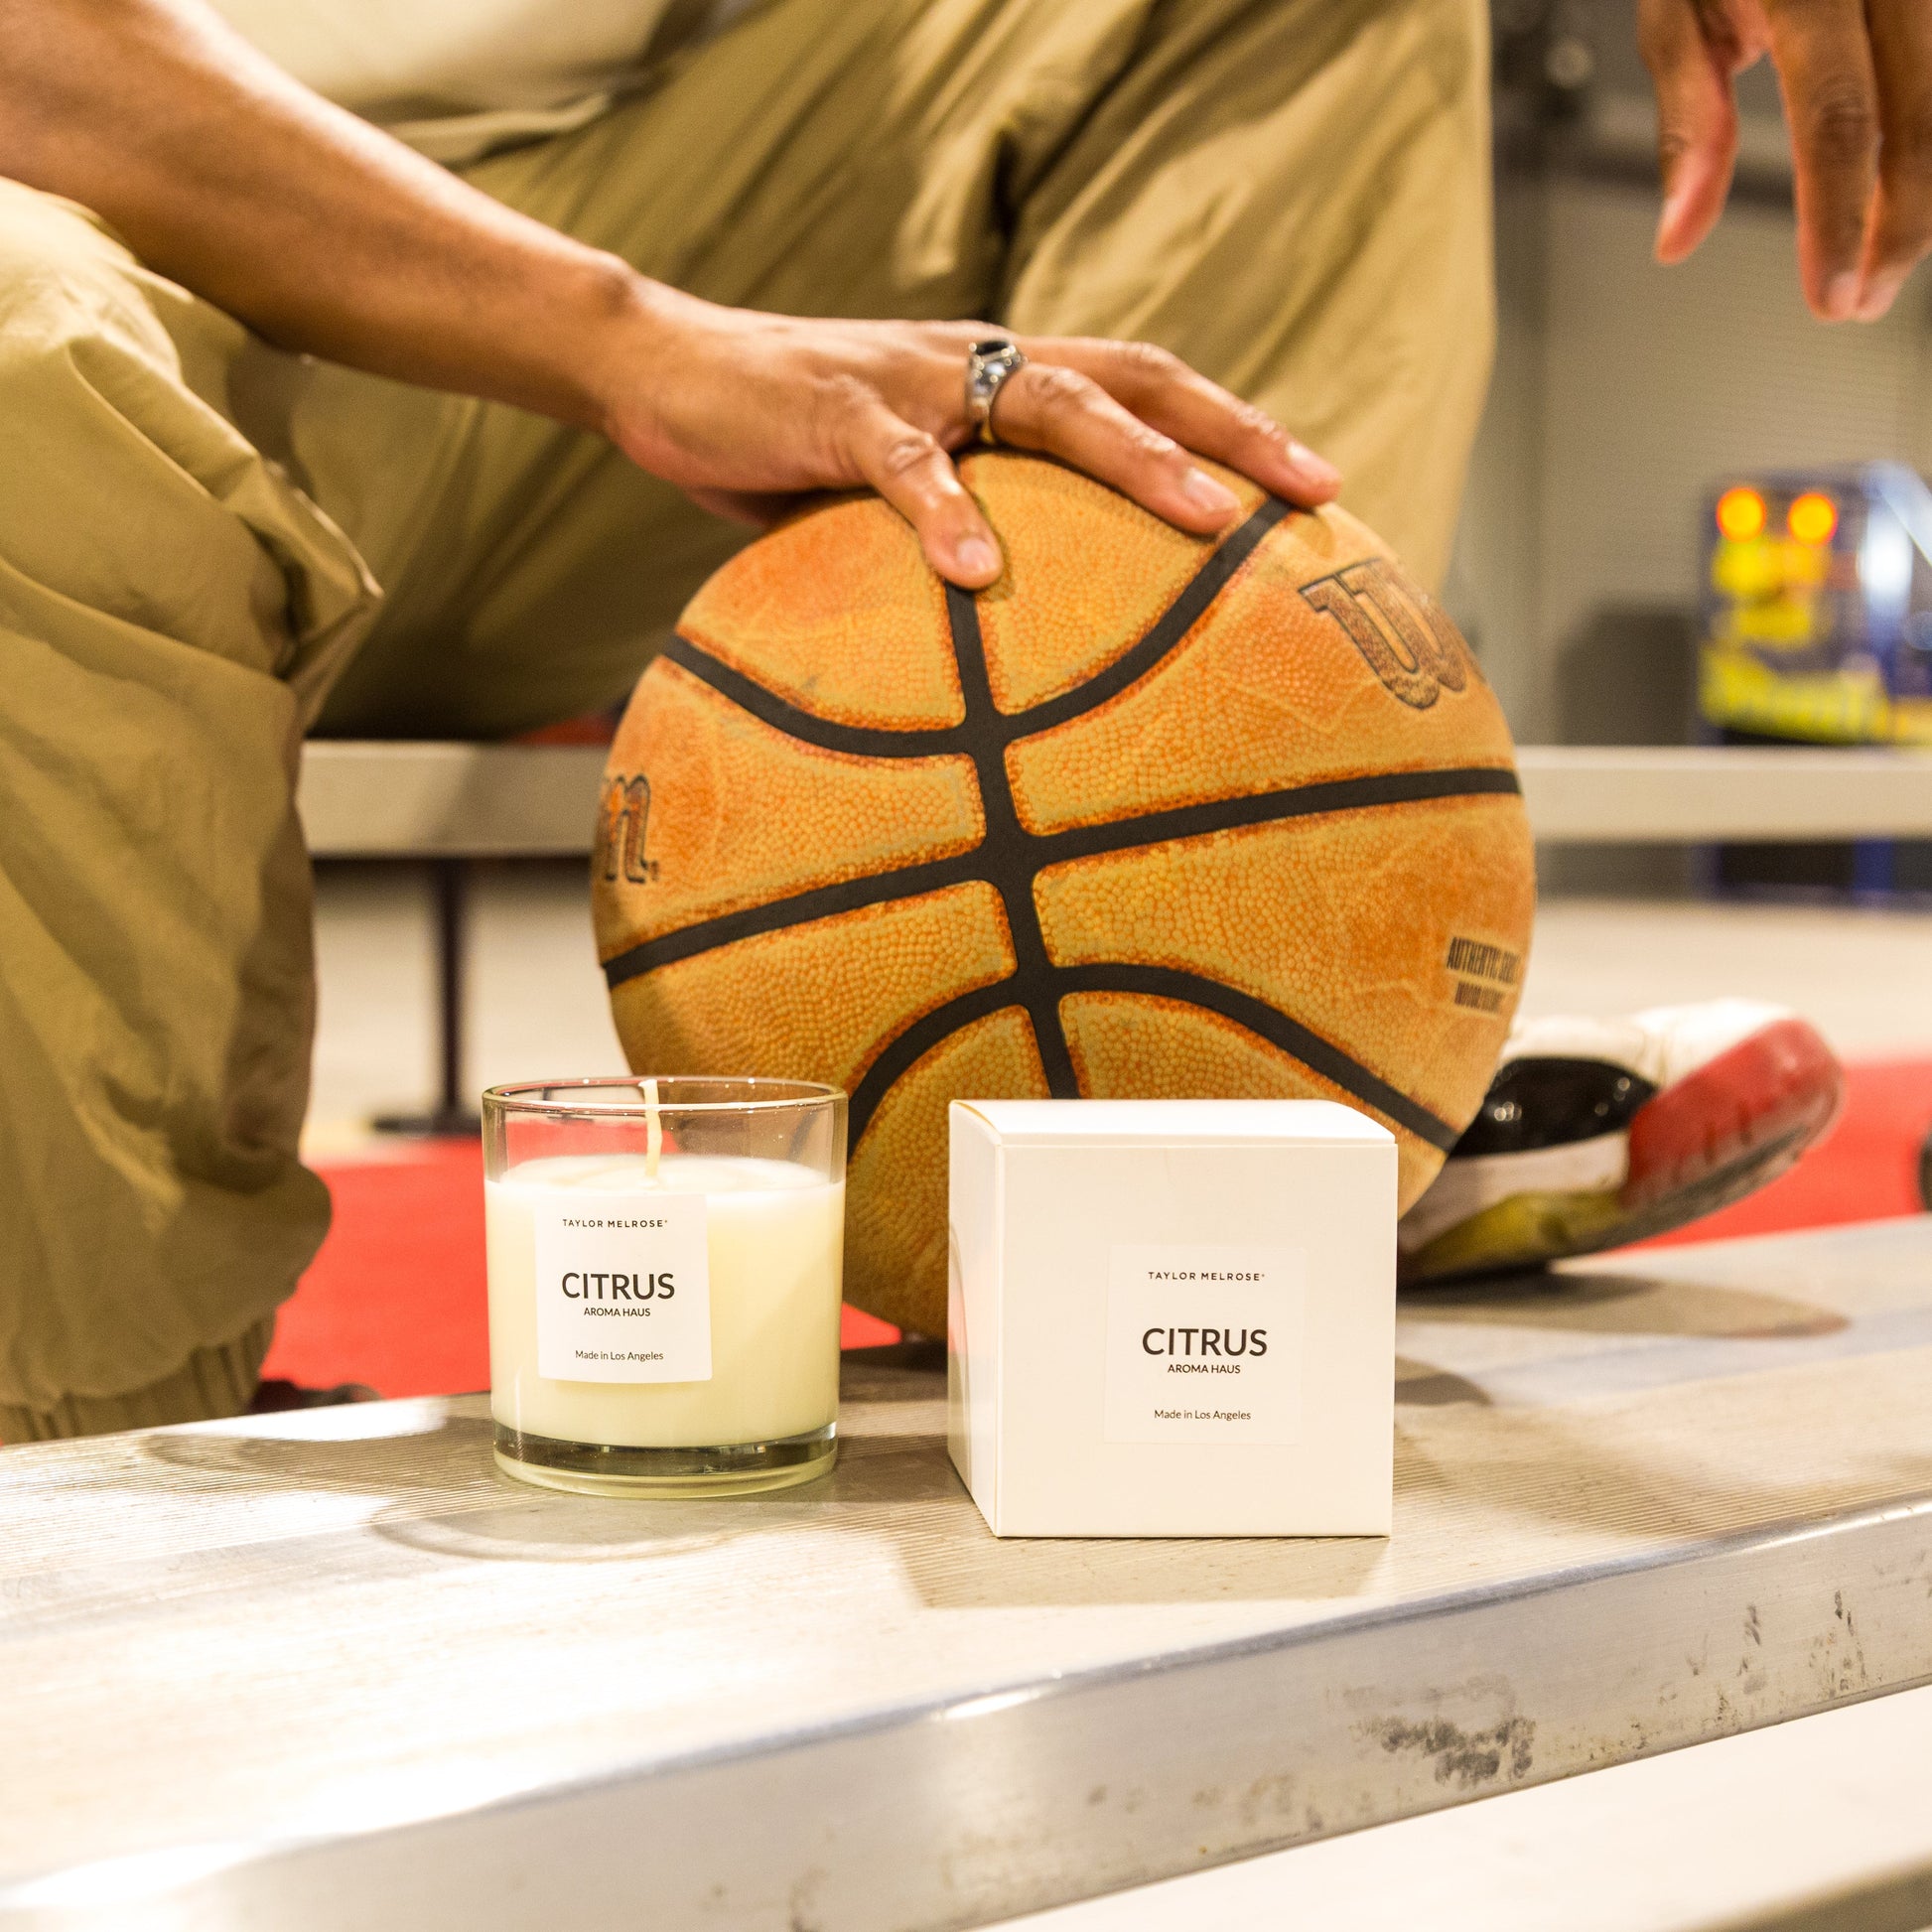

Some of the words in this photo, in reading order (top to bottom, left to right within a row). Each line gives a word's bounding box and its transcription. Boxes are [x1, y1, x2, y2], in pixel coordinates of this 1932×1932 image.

[562, 1218, 604, 1228] TAYLOR
[1148, 1271, 1196, 1281] TAYLOR
[561, 1272, 676, 1301] CITRUS
[583, 1307, 621, 1317] AROMA
[621, 1308, 651, 1317] HAUS
[1142, 1327, 1268, 1357] CITRUS
[575, 1349, 600, 1360] Made
[600, 1350, 610, 1361] in
[610, 1350, 626, 1361] Los
[626, 1350, 664, 1363] Angeles
[1167, 1363, 1209, 1374] AROMA
[1210, 1363, 1241, 1375] HAUS
[1154, 1409, 1181, 1420] Made
[1183, 1409, 1193, 1420] in
[1194, 1409, 1211, 1420] Los
[1212, 1410, 1252, 1422] Angeles
